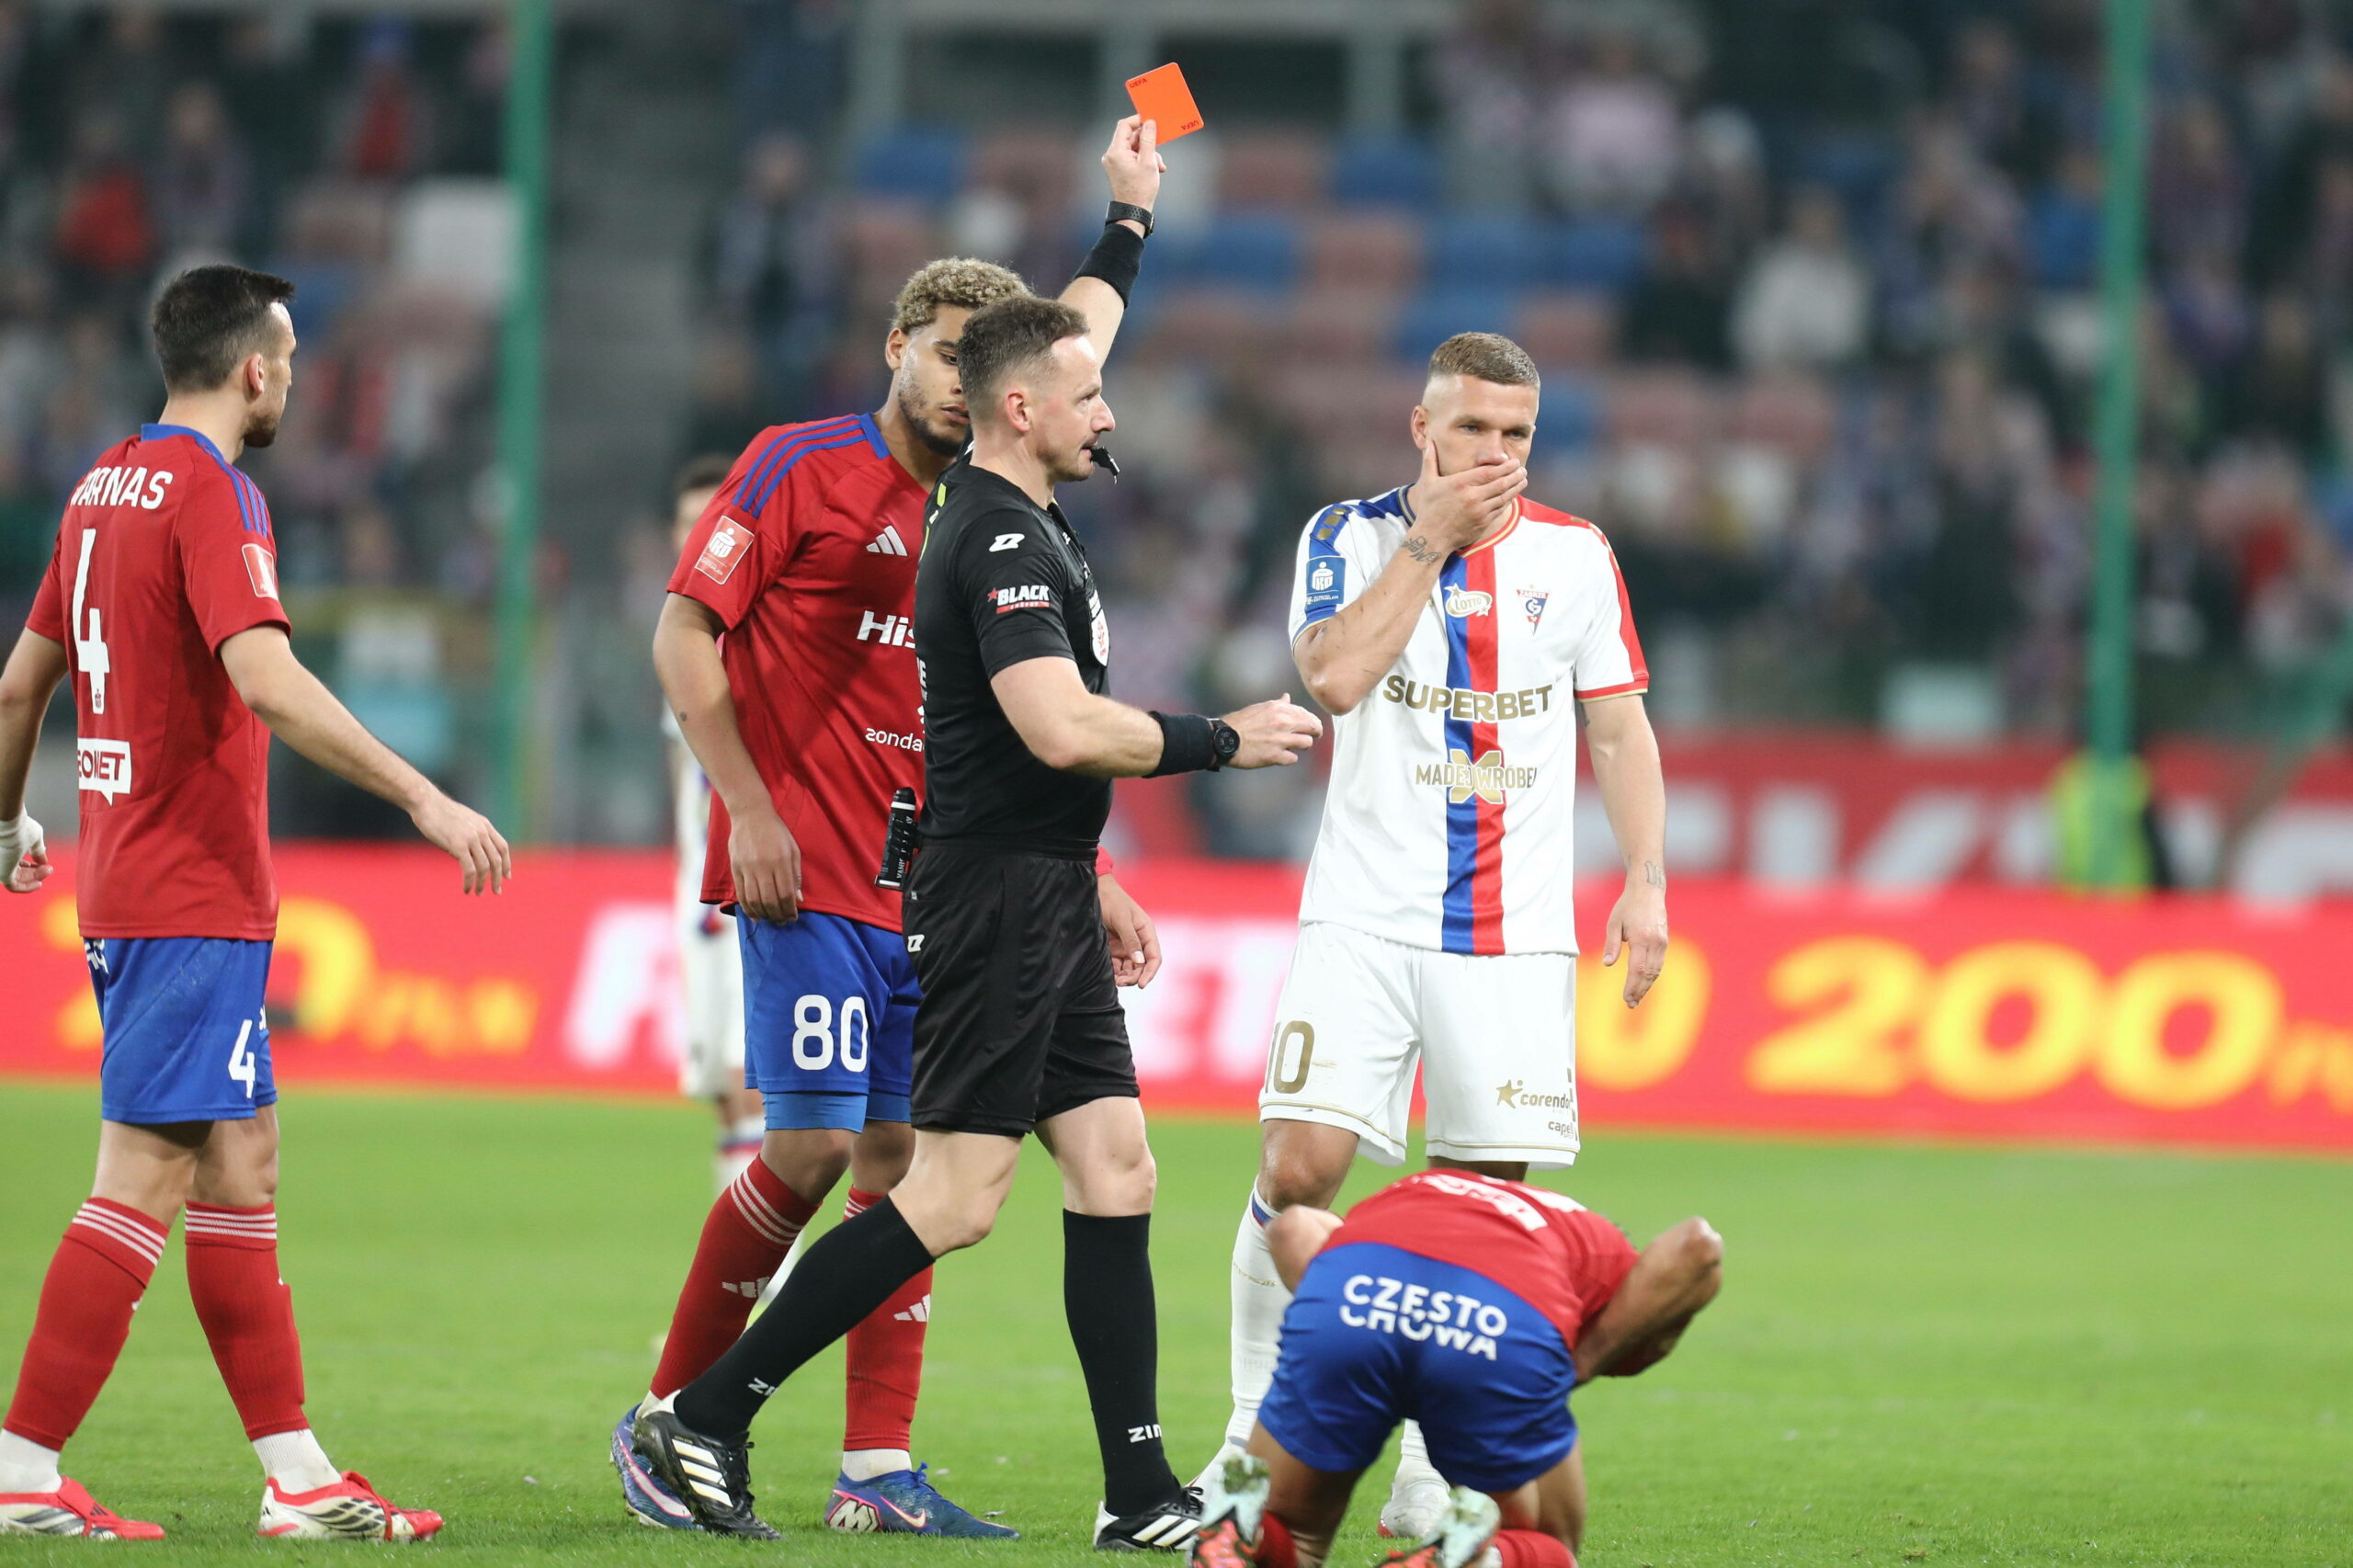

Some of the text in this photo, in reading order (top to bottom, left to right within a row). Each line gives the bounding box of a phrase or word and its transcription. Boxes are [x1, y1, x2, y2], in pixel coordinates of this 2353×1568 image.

[72, 528, 110, 714] 4
[997, 585, 1050, 607] BLACK
[1382, 675, 1553, 721] SUPERBET
[865, 727, 924, 752] zonda
[228, 1019, 256, 1098] 4
[792, 994, 869, 1073] 80
[1265, 1020, 1314, 1094] 10
